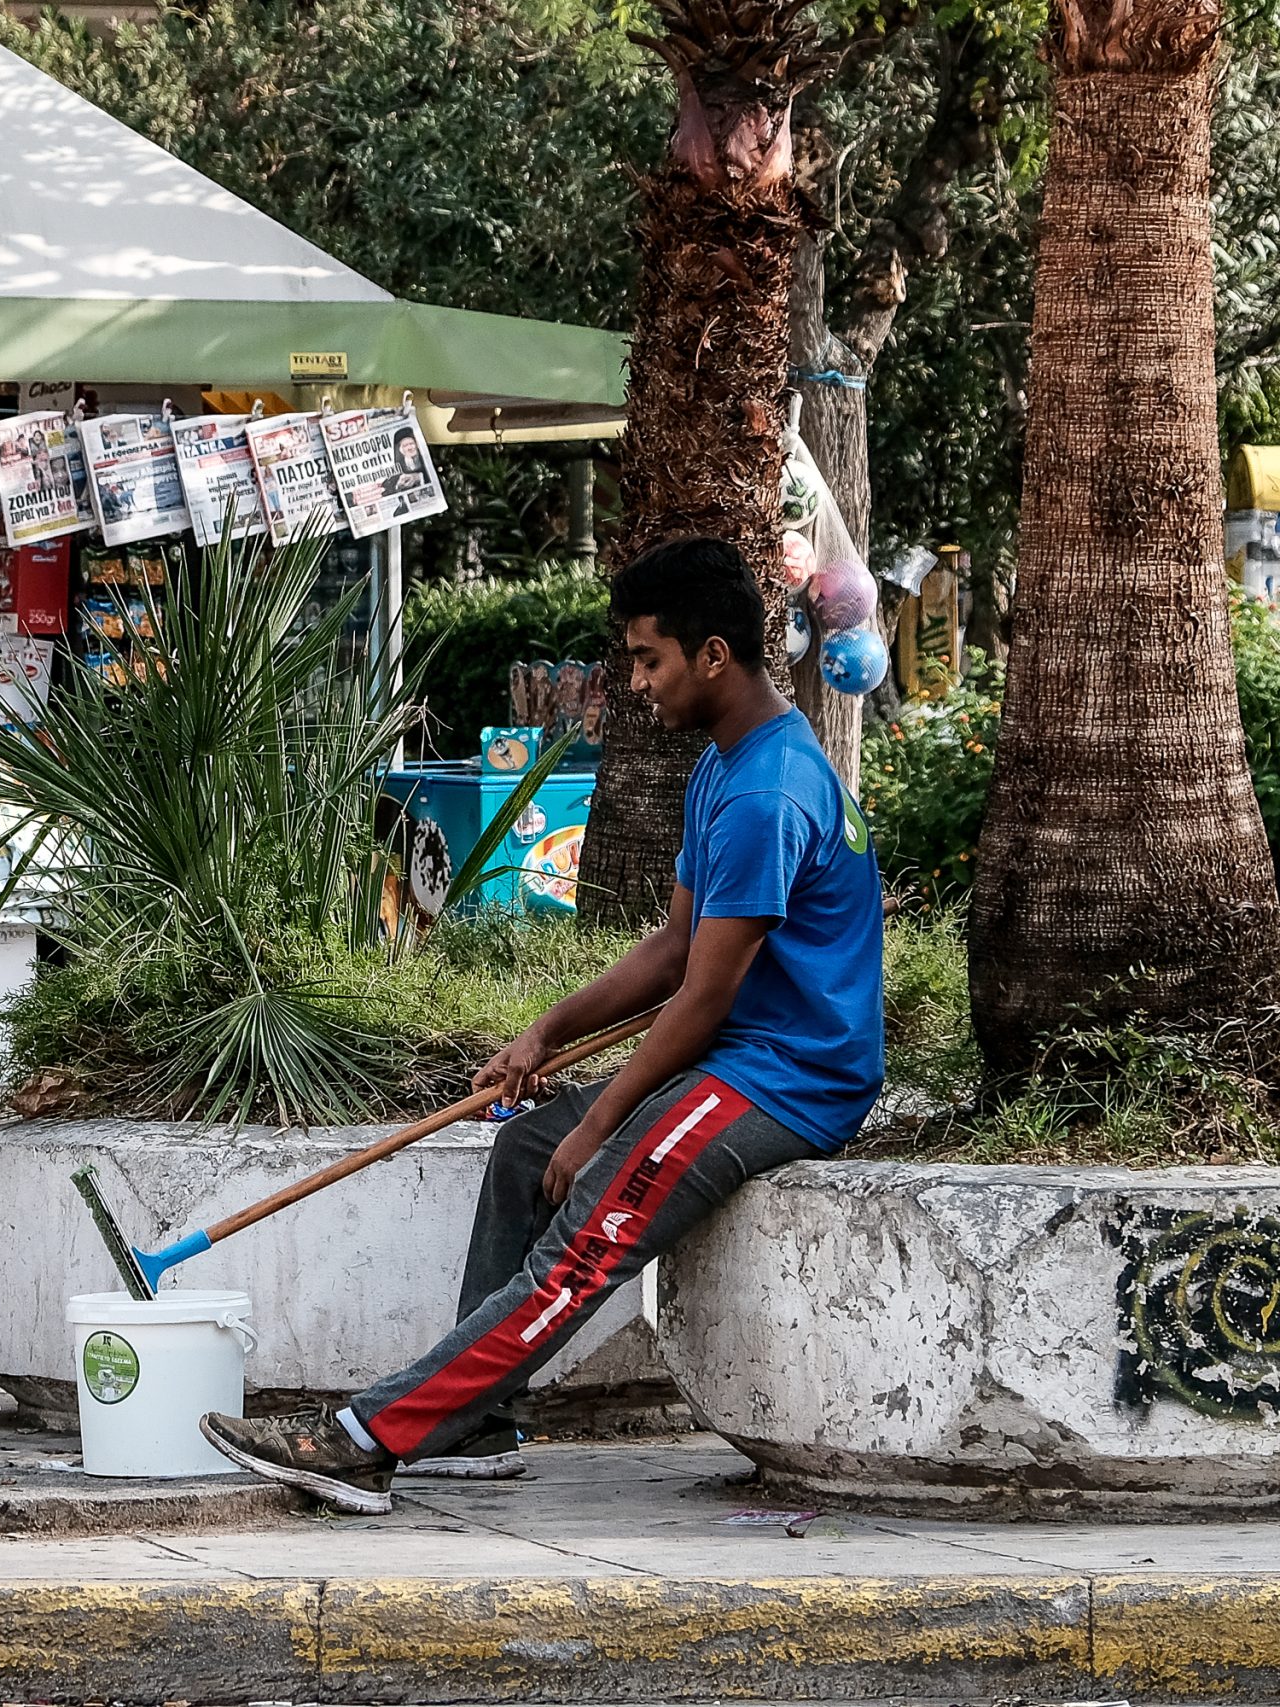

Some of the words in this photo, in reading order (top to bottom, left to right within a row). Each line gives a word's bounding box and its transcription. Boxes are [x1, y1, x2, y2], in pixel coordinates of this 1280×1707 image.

[293, 355, 343, 364] TENTART
[328, 418, 365, 441] Star
[332, 433, 392, 464] ΜΑΣΚΟΦΟΡΟΙ
[337, 463, 359, 478] στο
[362, 453, 393, 470] σπίτι
[28, 613, 56, 626] 250gr
[618, 1156, 664, 1209] BLUE
